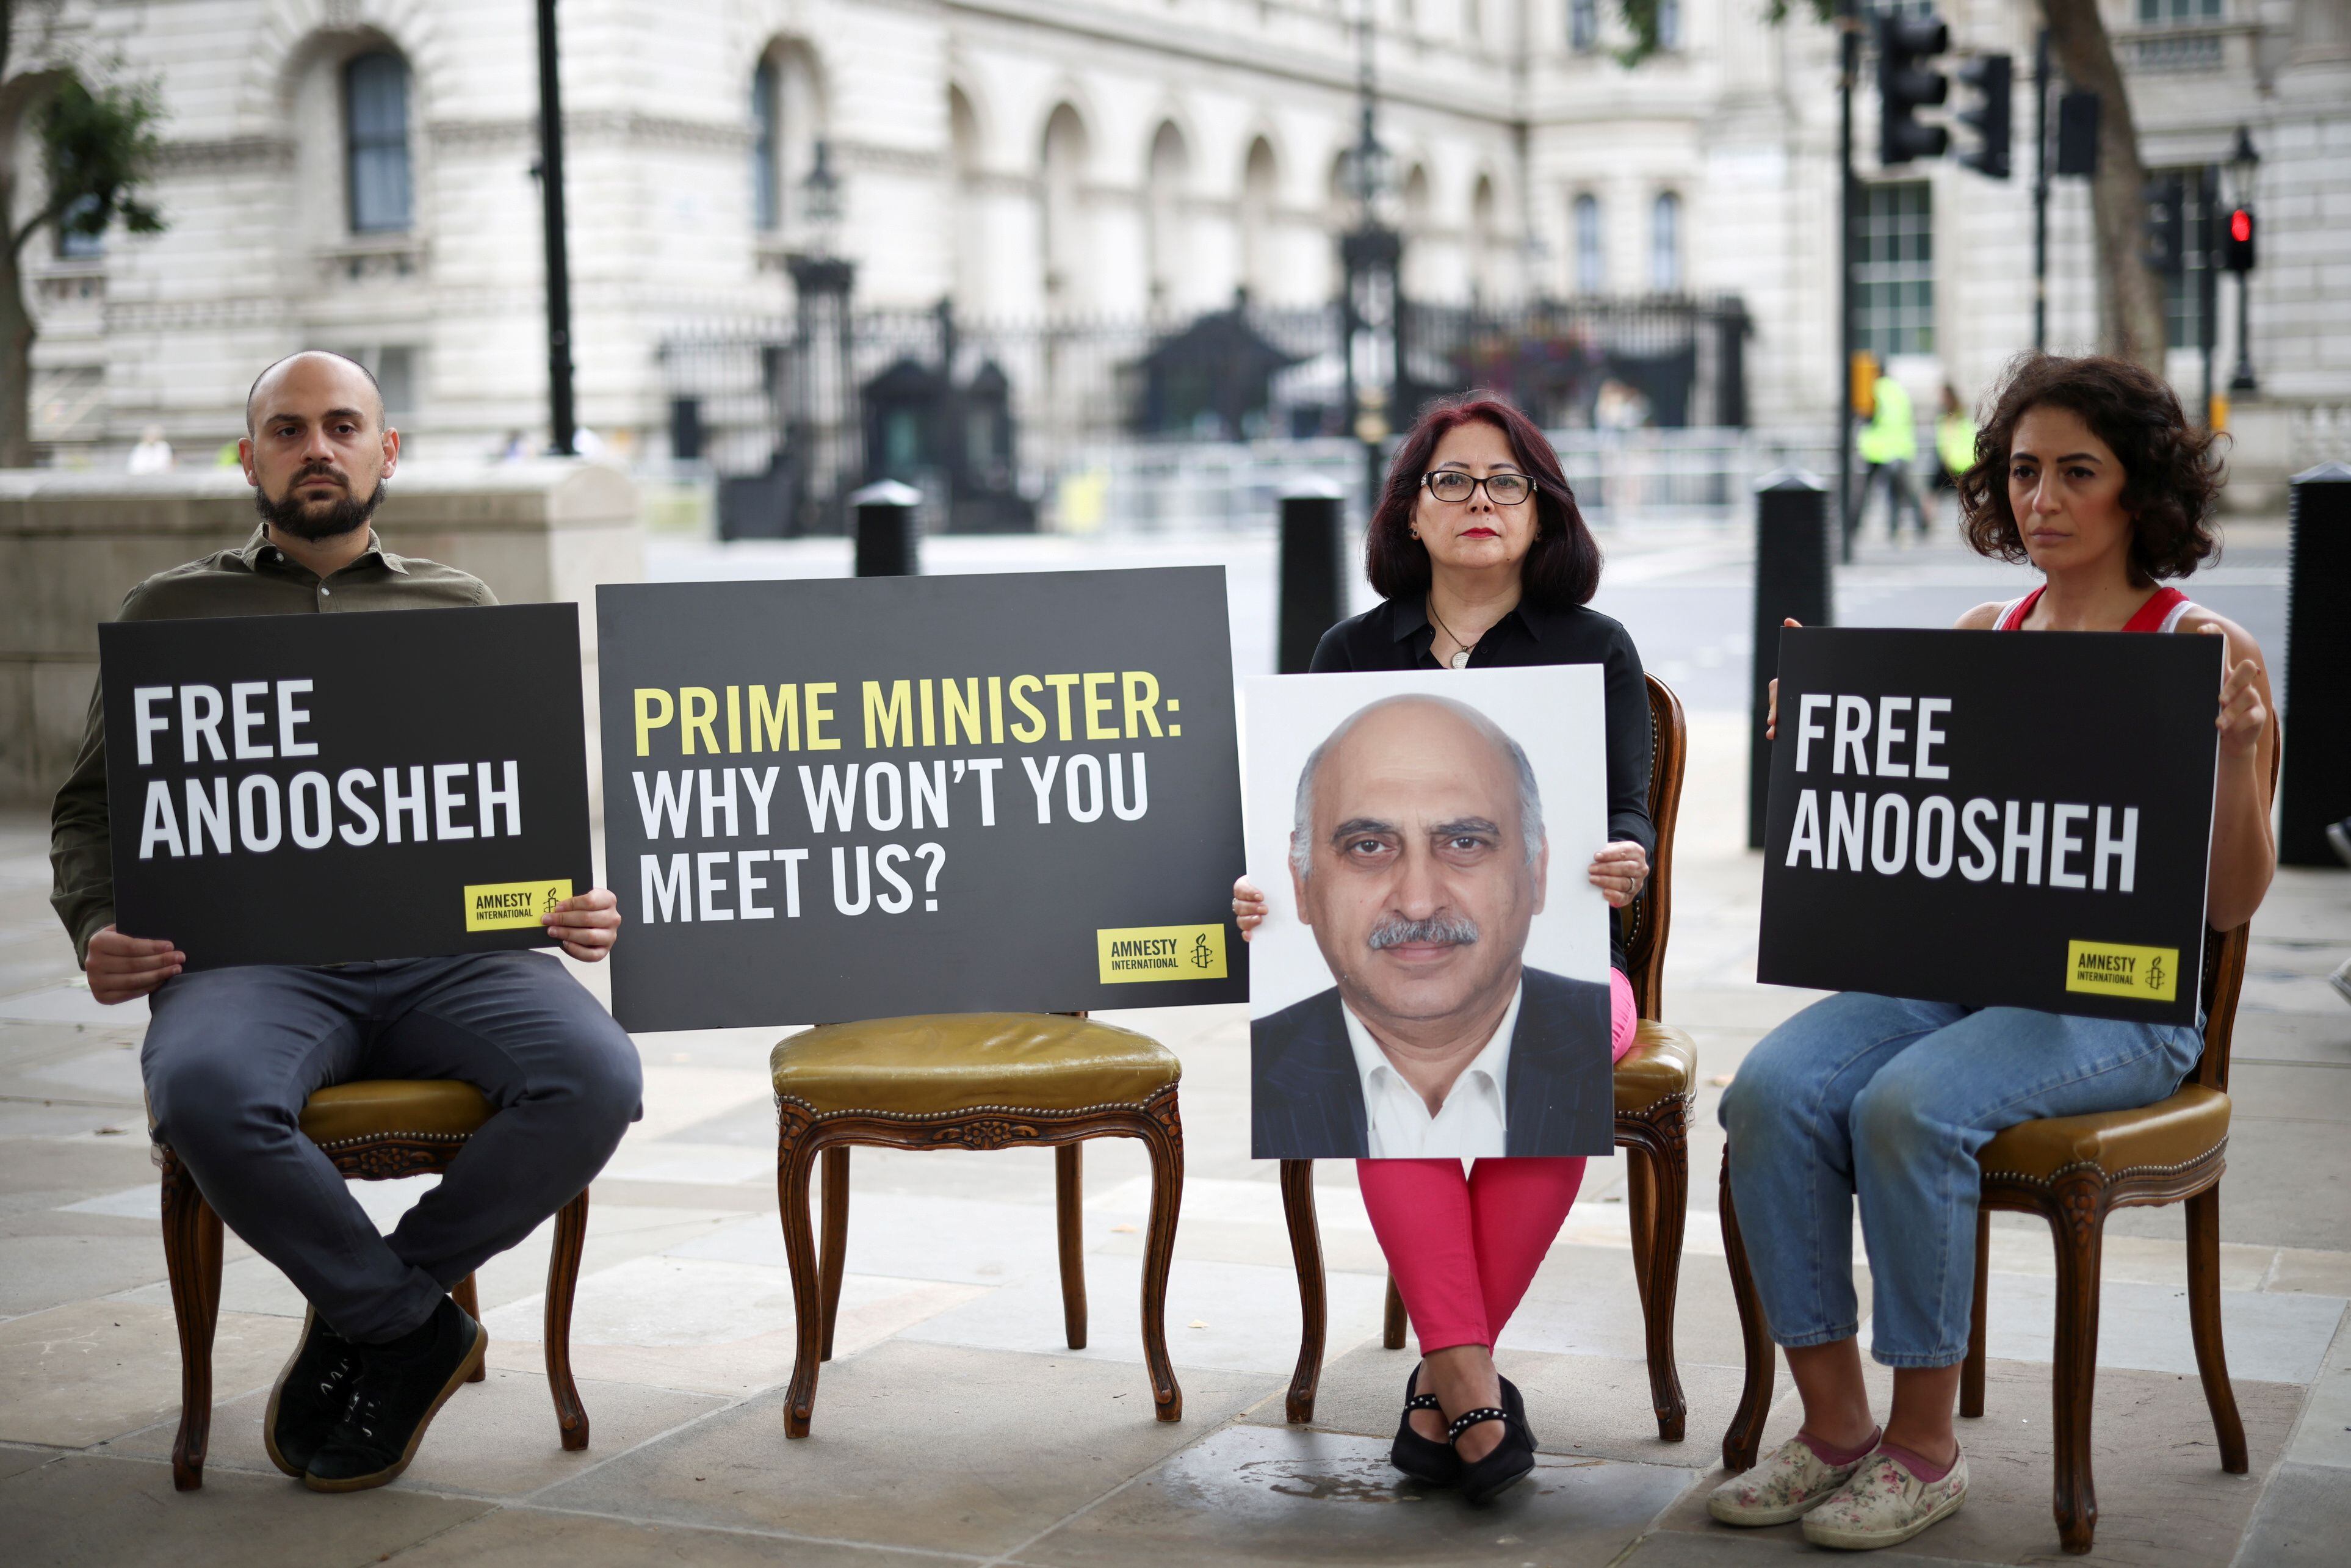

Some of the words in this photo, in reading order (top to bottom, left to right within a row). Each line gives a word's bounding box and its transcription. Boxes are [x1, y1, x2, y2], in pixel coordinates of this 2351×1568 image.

[134, 679, 319, 765] FREE
[634, 682, 841, 757] PRIME
[862, 671, 1182, 749] MINISTER:
[1796, 694, 1952, 780] FREE
[139, 761, 521, 859] ANOOSHEH
[632, 766, 781, 840] WHY
[798, 757, 1003, 833] WON’T
[1020, 752, 1148, 824] YOU
[1785, 789, 2139, 893] ANOOSHEH
[476, 892, 532, 909] AMNESTY
[477, 908, 533, 920] INTERNATIONAL
[641, 848, 809, 924] MEET
[832, 842, 946, 916] US?
[1111, 939, 1177, 958] AMNESTY
[1111, 958, 1179, 970] INTERNATIONAL
[2077, 970, 2134, 985] INTERNATIONAL
[2078, 953, 2136, 973] AMNESTY
